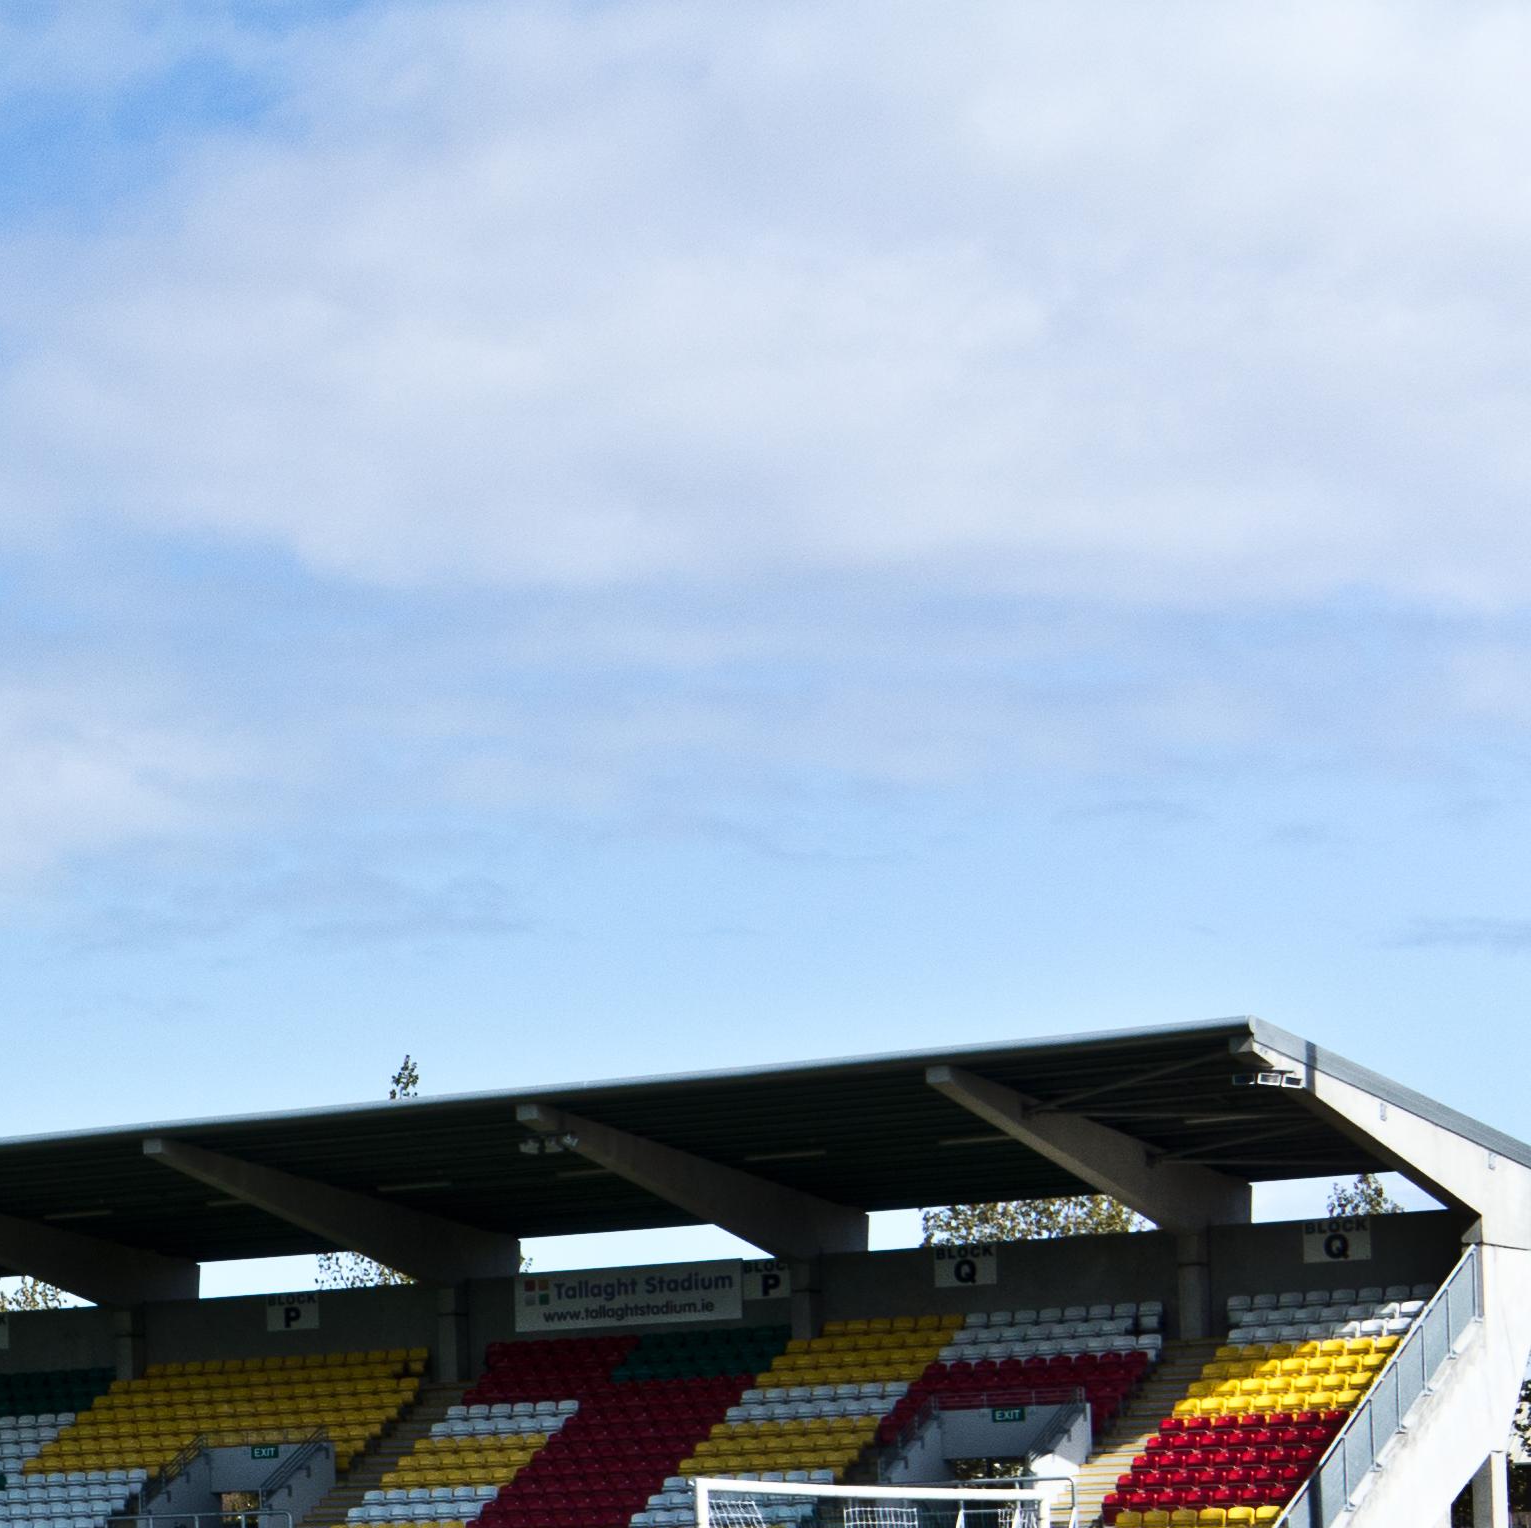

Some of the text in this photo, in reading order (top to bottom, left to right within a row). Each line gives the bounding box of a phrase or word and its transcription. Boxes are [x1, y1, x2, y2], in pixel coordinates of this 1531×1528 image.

[1305, 1218, 1368, 1234] BLOCK
[935, 1245, 993, 1260] BLOCK
[1324, 1233, 1349, 1259] Q
[954, 1259, 976, 1283] Q
[554, 1272, 733, 1301] Tallaght Stadium
[762, 1274, 780, 1296] P
[284, 1307, 301, 1328] P
[543, 1299, 715, 1322] www.tallaghtstadium.ie
[995, 1409, 1020, 1421] EXIT
[254, 1447, 276, 1457] EXIT
